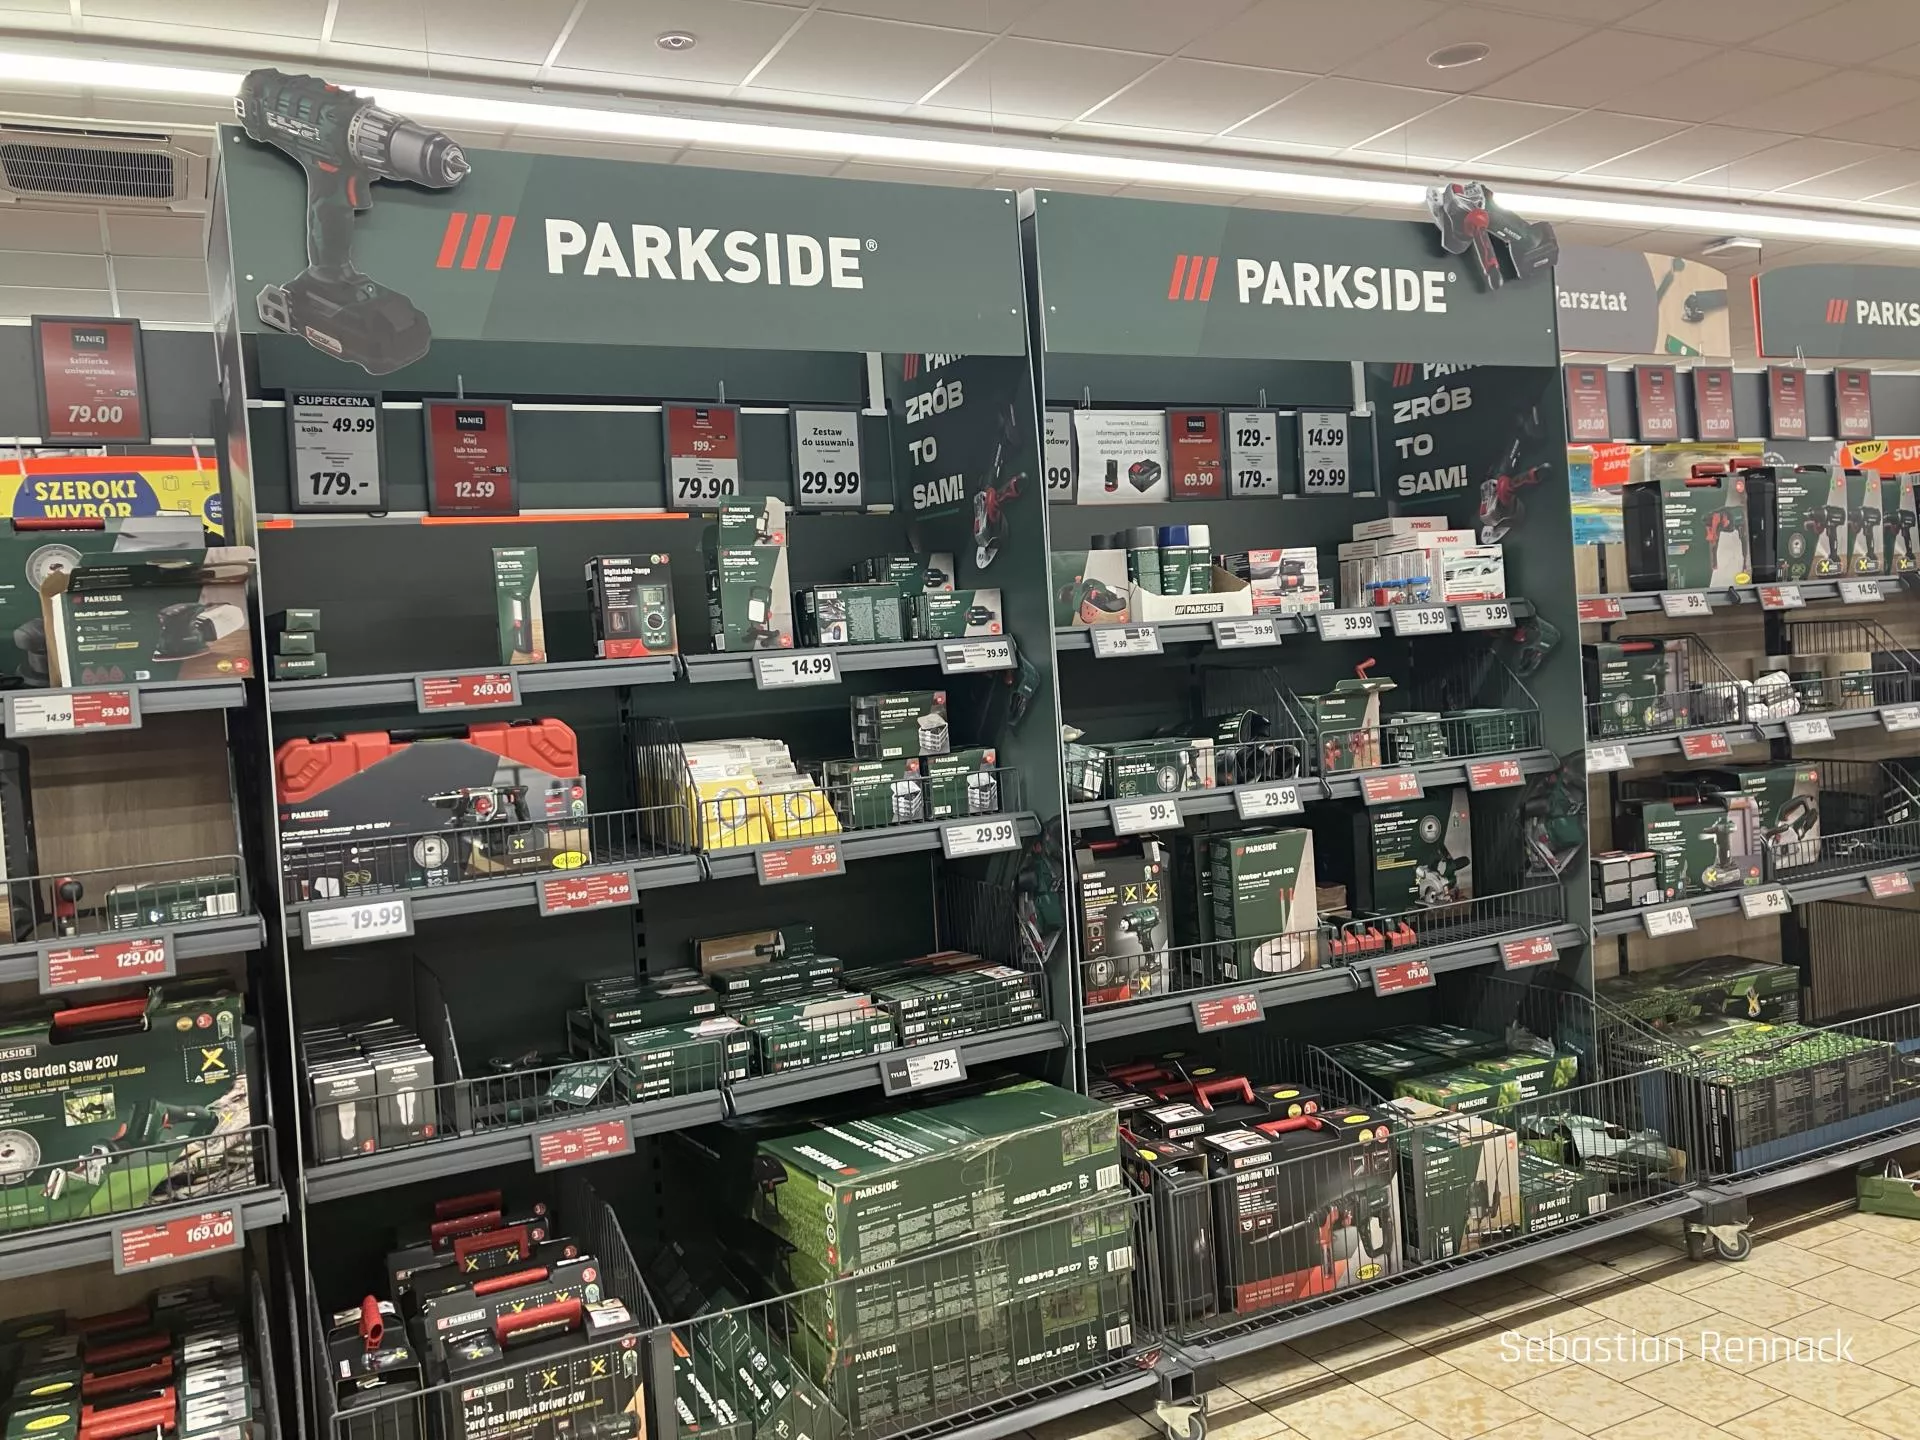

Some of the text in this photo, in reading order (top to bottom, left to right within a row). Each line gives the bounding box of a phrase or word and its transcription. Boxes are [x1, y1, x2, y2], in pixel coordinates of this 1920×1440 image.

[1555, 285, 1628, 312] arsztat
[75, 335, 105, 344] TANIEJ
[298, 396, 370, 407] SUPERCENA
[905, 379, 965, 424] ZRÓB
[1393, 386, 1473, 424] ZRÓB
[68, 405, 123, 423] 79.00
[458, 417, 484, 425] TANIEJ
[301, 426, 323, 434] kolba
[332, 417, 375, 433] 49.99
[812, 427, 843, 437] Zestaw
[802, 438, 855, 448] do usuwania
[1307, 429, 1344, 446] 14.99
[909, 436, 938, 466] TO
[1396, 434, 1434, 459] TO
[1854, 443, 1882, 457] ceny
[310, 472, 369, 496] 179.-
[801, 472, 860, 494] 29.99
[1184, 473, 1213, 486] 69.90
[1307, 468, 1346, 487] 29.99
[1398, 465, 1468, 496] SAM!
[35, 480, 138, 501] SZEROKI
[454, 481, 495, 498] 12.59
[678, 477, 734, 499] 79.90
[913, 473, 965, 510] SAM!
[1857, 583, 1879, 595] 14.99
[1187, 604, 1222, 614] PARKSIDE
[1486, 607, 1507, 620] 9.99
[1344, 615, 1372, 630] 39.99
[1418, 611, 1444, 625] 19.99
[1254, 625, 1273, 635] 39.99
[1113, 640, 1127, 648] 9.99
[986, 648, 1009, 658] 39.99
[791, 658, 832, 676] 14.99
[473, 682, 512, 696] 249.00
[46, 712, 72, 722] 14.99
[101, 707, 130, 718] 59.90
[1265, 791, 1296, 807] 29.99
[291, 810, 330, 820] PARKSIDE
[975, 825, 1013, 844] 29.99
[1245, 842, 1278, 854] PARKSIDE
[812, 852, 837, 865] 39.99
[1238, 867, 1294, 882] Water Level Kit
[567, 890, 588, 900] 34.99
[608, 885, 629, 895] 34.99
[351, 906, 403, 930] 19.99
[116, 948, 165, 968] 129.00
[1407, 967, 1429, 980] 179.00
[616, 1010, 641, 1018] PARKSIDE
[1232, 1001, 1257, 1014] 199.00
[24, 1054, 119, 1080] Garden Saw 20V
[891, 1070, 907, 1078] TYLKO
[83, 1072, 107, 1082] charger
[1458, 1097, 1488, 1109] PARKSIDE
[855, 1180, 900, 1200] PARKSIDE
[186, 1220, 233, 1243] 169.00
[449, 1311, 483, 1325] PARKSIDE
[776, 1419, 789, 1439] 3L
